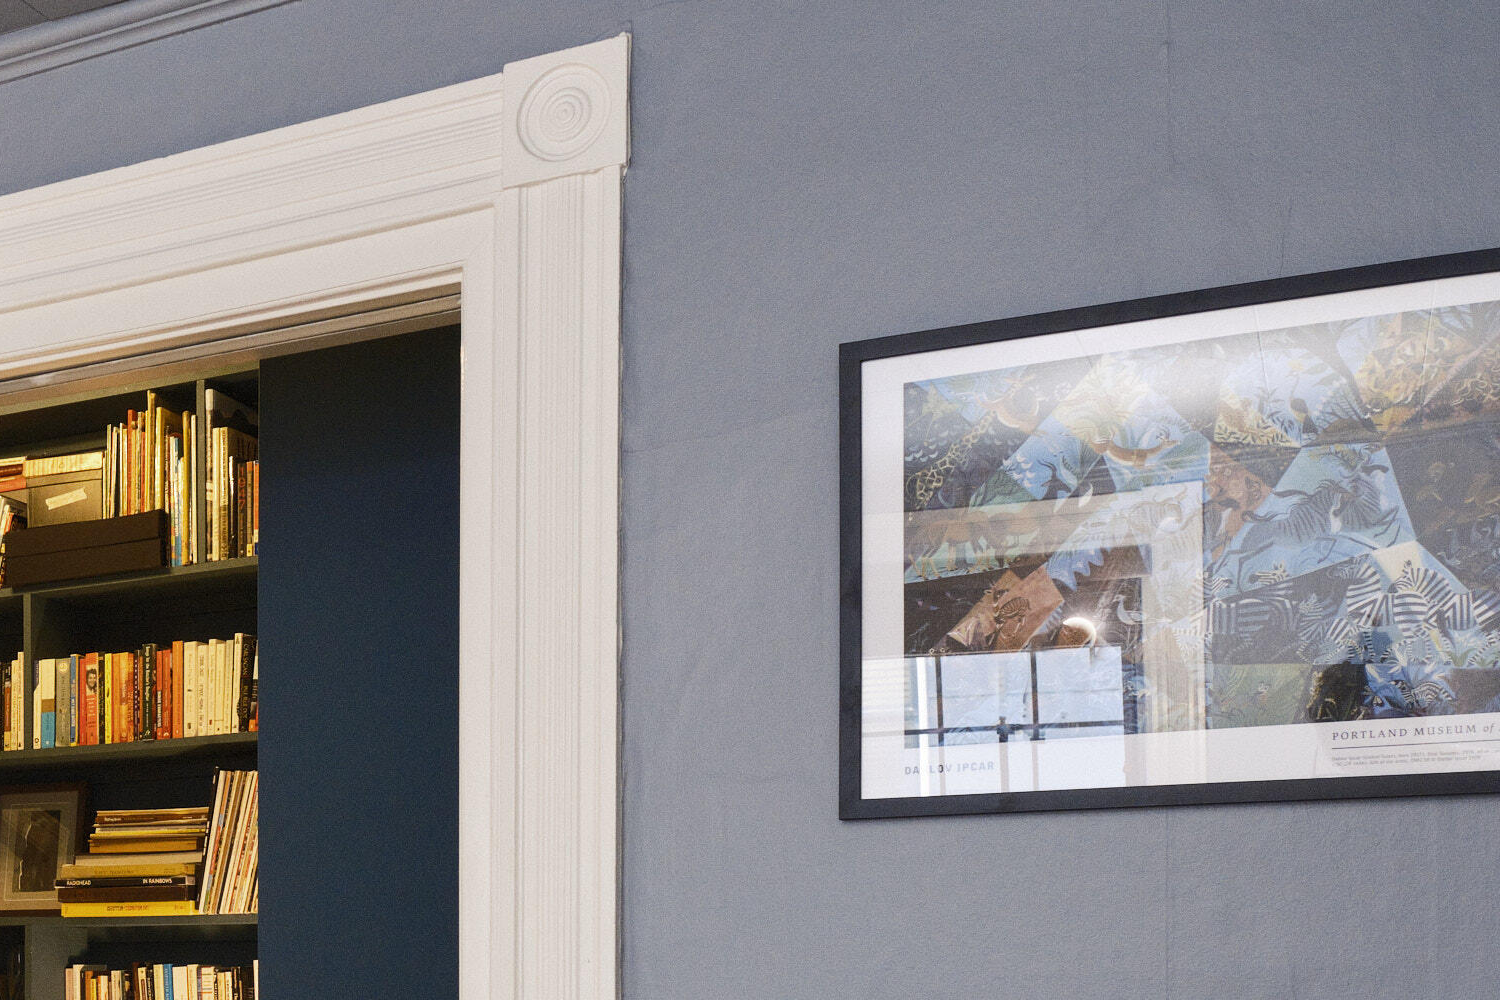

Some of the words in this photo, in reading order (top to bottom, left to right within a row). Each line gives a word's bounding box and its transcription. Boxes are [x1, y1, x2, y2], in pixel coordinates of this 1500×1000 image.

[1332, 728, 1408, 741] PORTLAND
[1414, 724, 1476, 736] MUSEUM
[1483, 723, 1496, 735] of
[904, 763, 952, 775] DALOV
[957, 761, 995, 773] IPCAR
